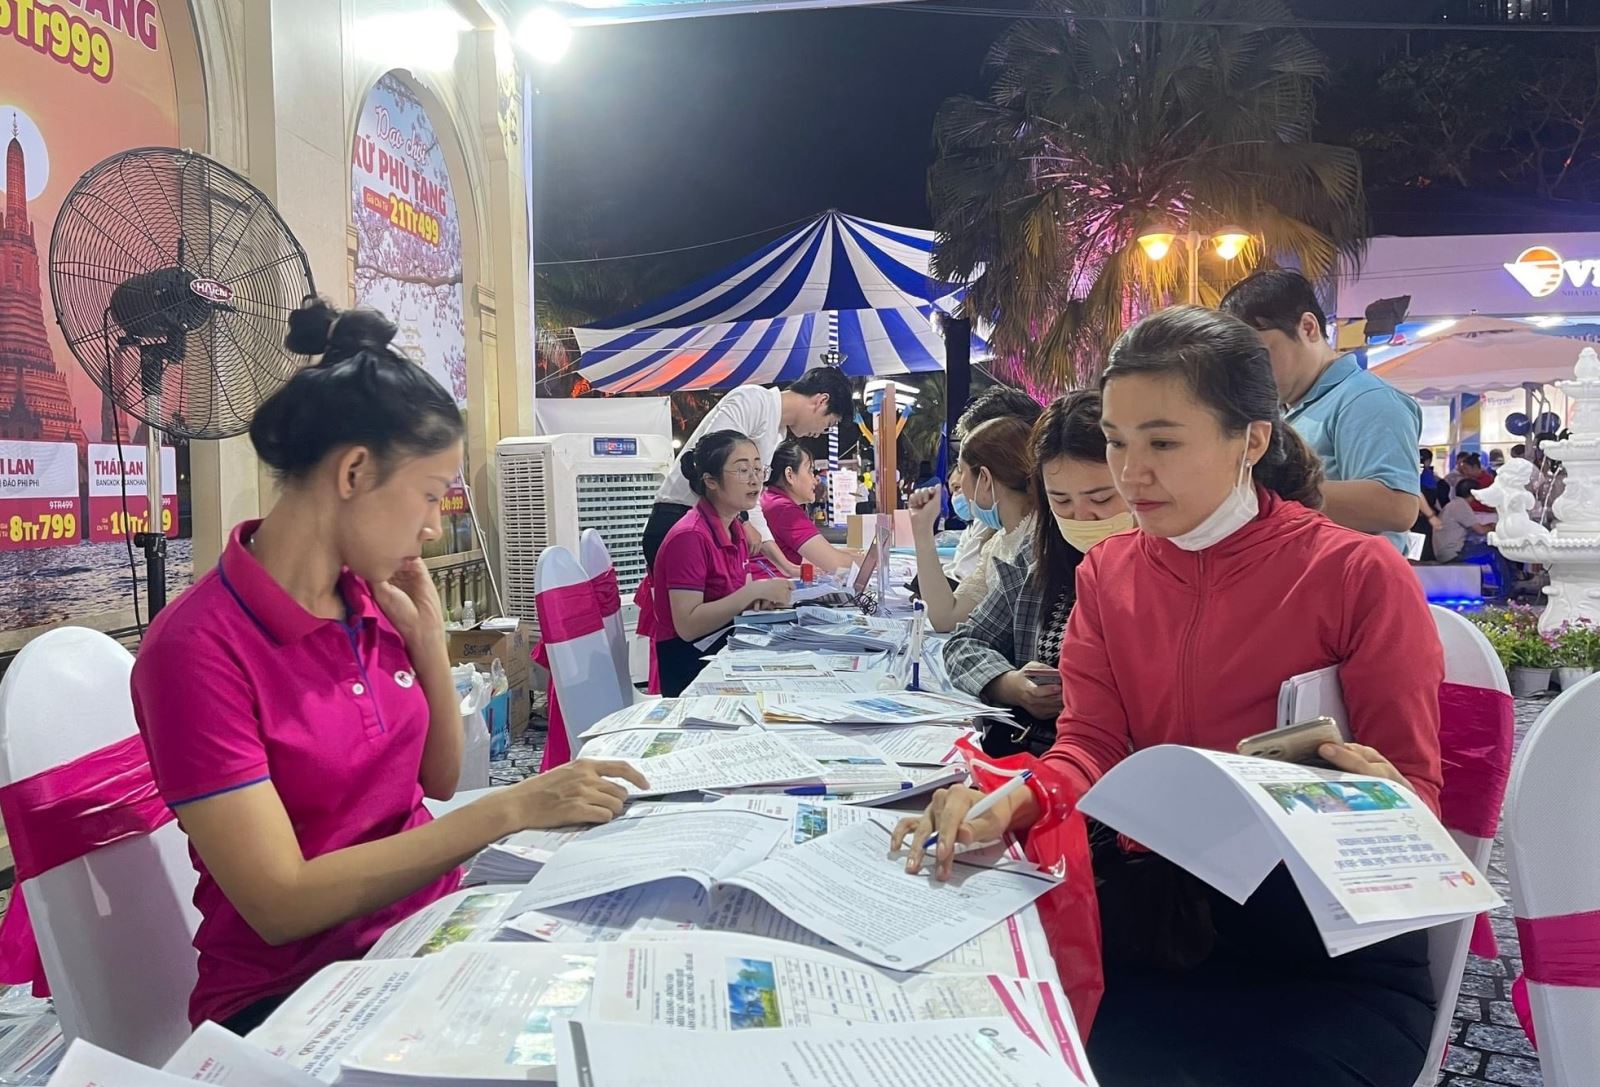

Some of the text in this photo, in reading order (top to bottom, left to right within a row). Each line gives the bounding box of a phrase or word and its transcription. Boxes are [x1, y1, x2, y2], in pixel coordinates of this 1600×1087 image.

[378, 148, 410, 195] PHÙ
[412, 170, 447, 217] TANG
[389, 193, 440, 245] 21Tr499
[7, 458, 35, 475] LAN
[95, 458, 144, 476] THÁI LAN
[17, 478, 28, 488] PHI
[29, 479, 40, 488] PHI
[9, 513, 77, 542] 8Tr799
